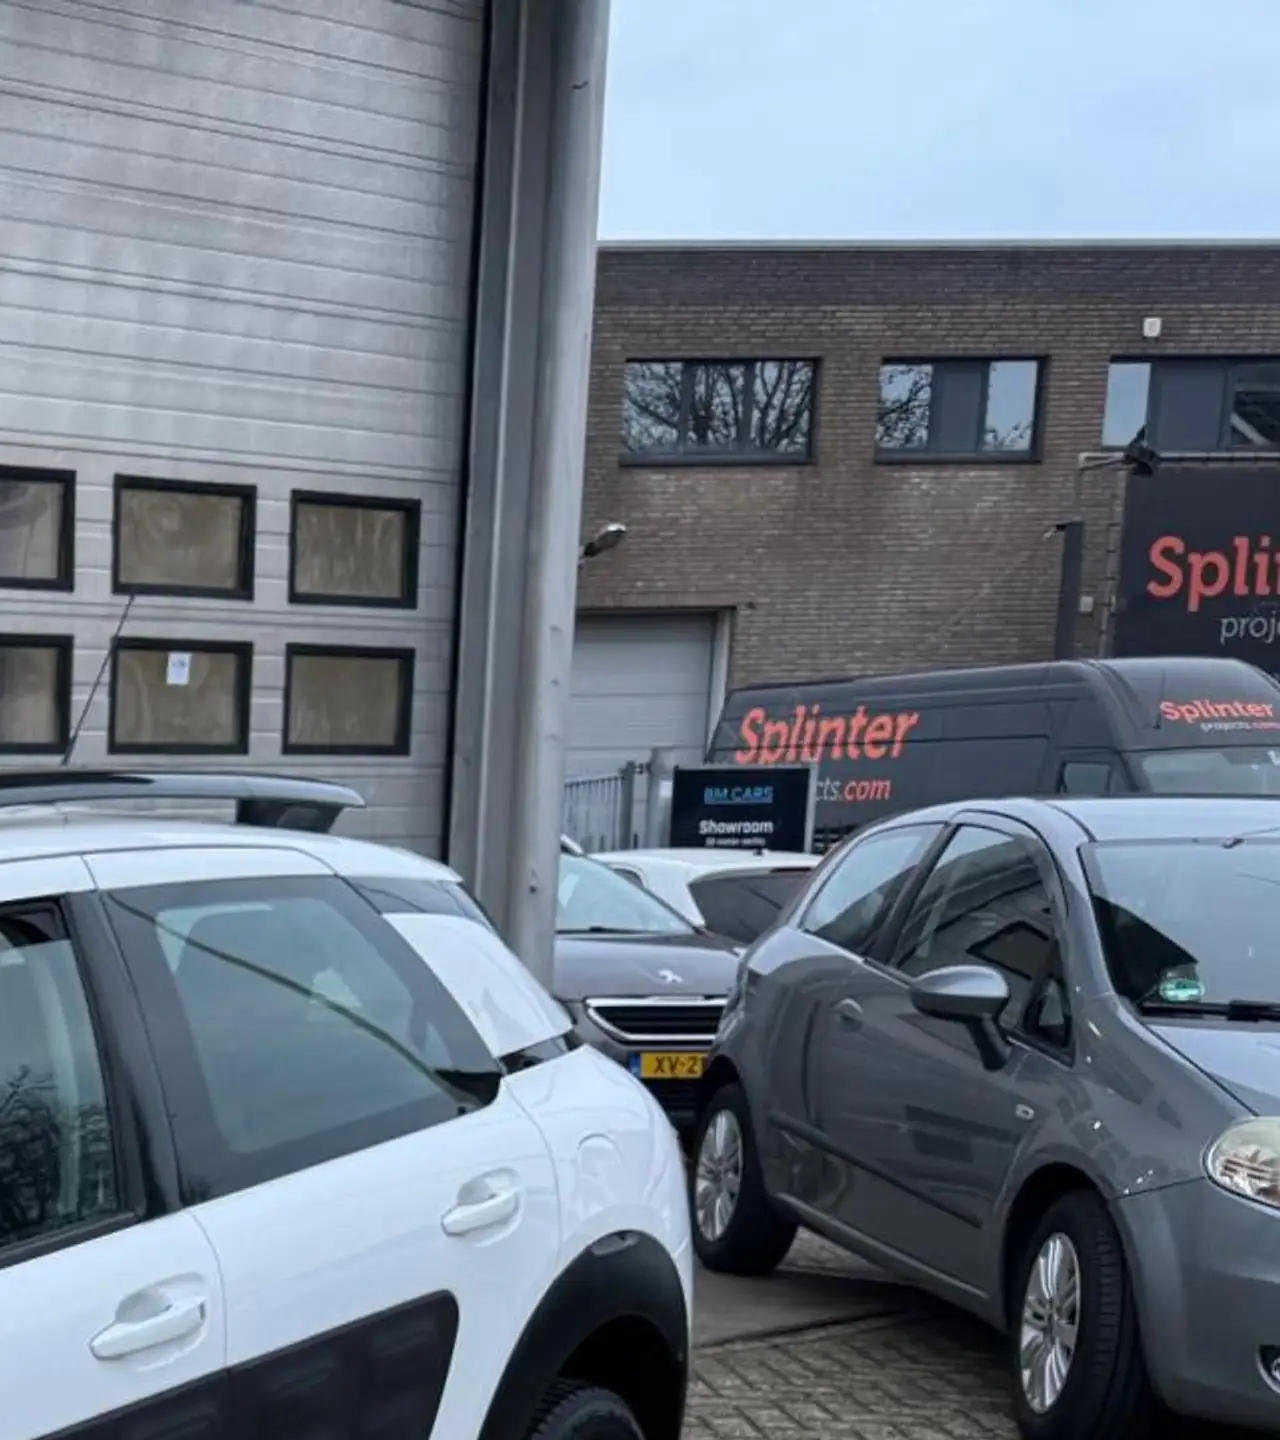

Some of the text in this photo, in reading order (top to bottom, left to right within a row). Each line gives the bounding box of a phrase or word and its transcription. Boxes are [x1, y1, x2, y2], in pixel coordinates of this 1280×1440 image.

[1146, 535, 1280, 613] Spli
[1219, 610, 1280, 645] proj
[1160, 700, 1273, 724] Splinter
[735, 704, 919, 766] Splinter
[731, 785, 774, 802] CARS
[699, 819, 774, 834] Showroom
